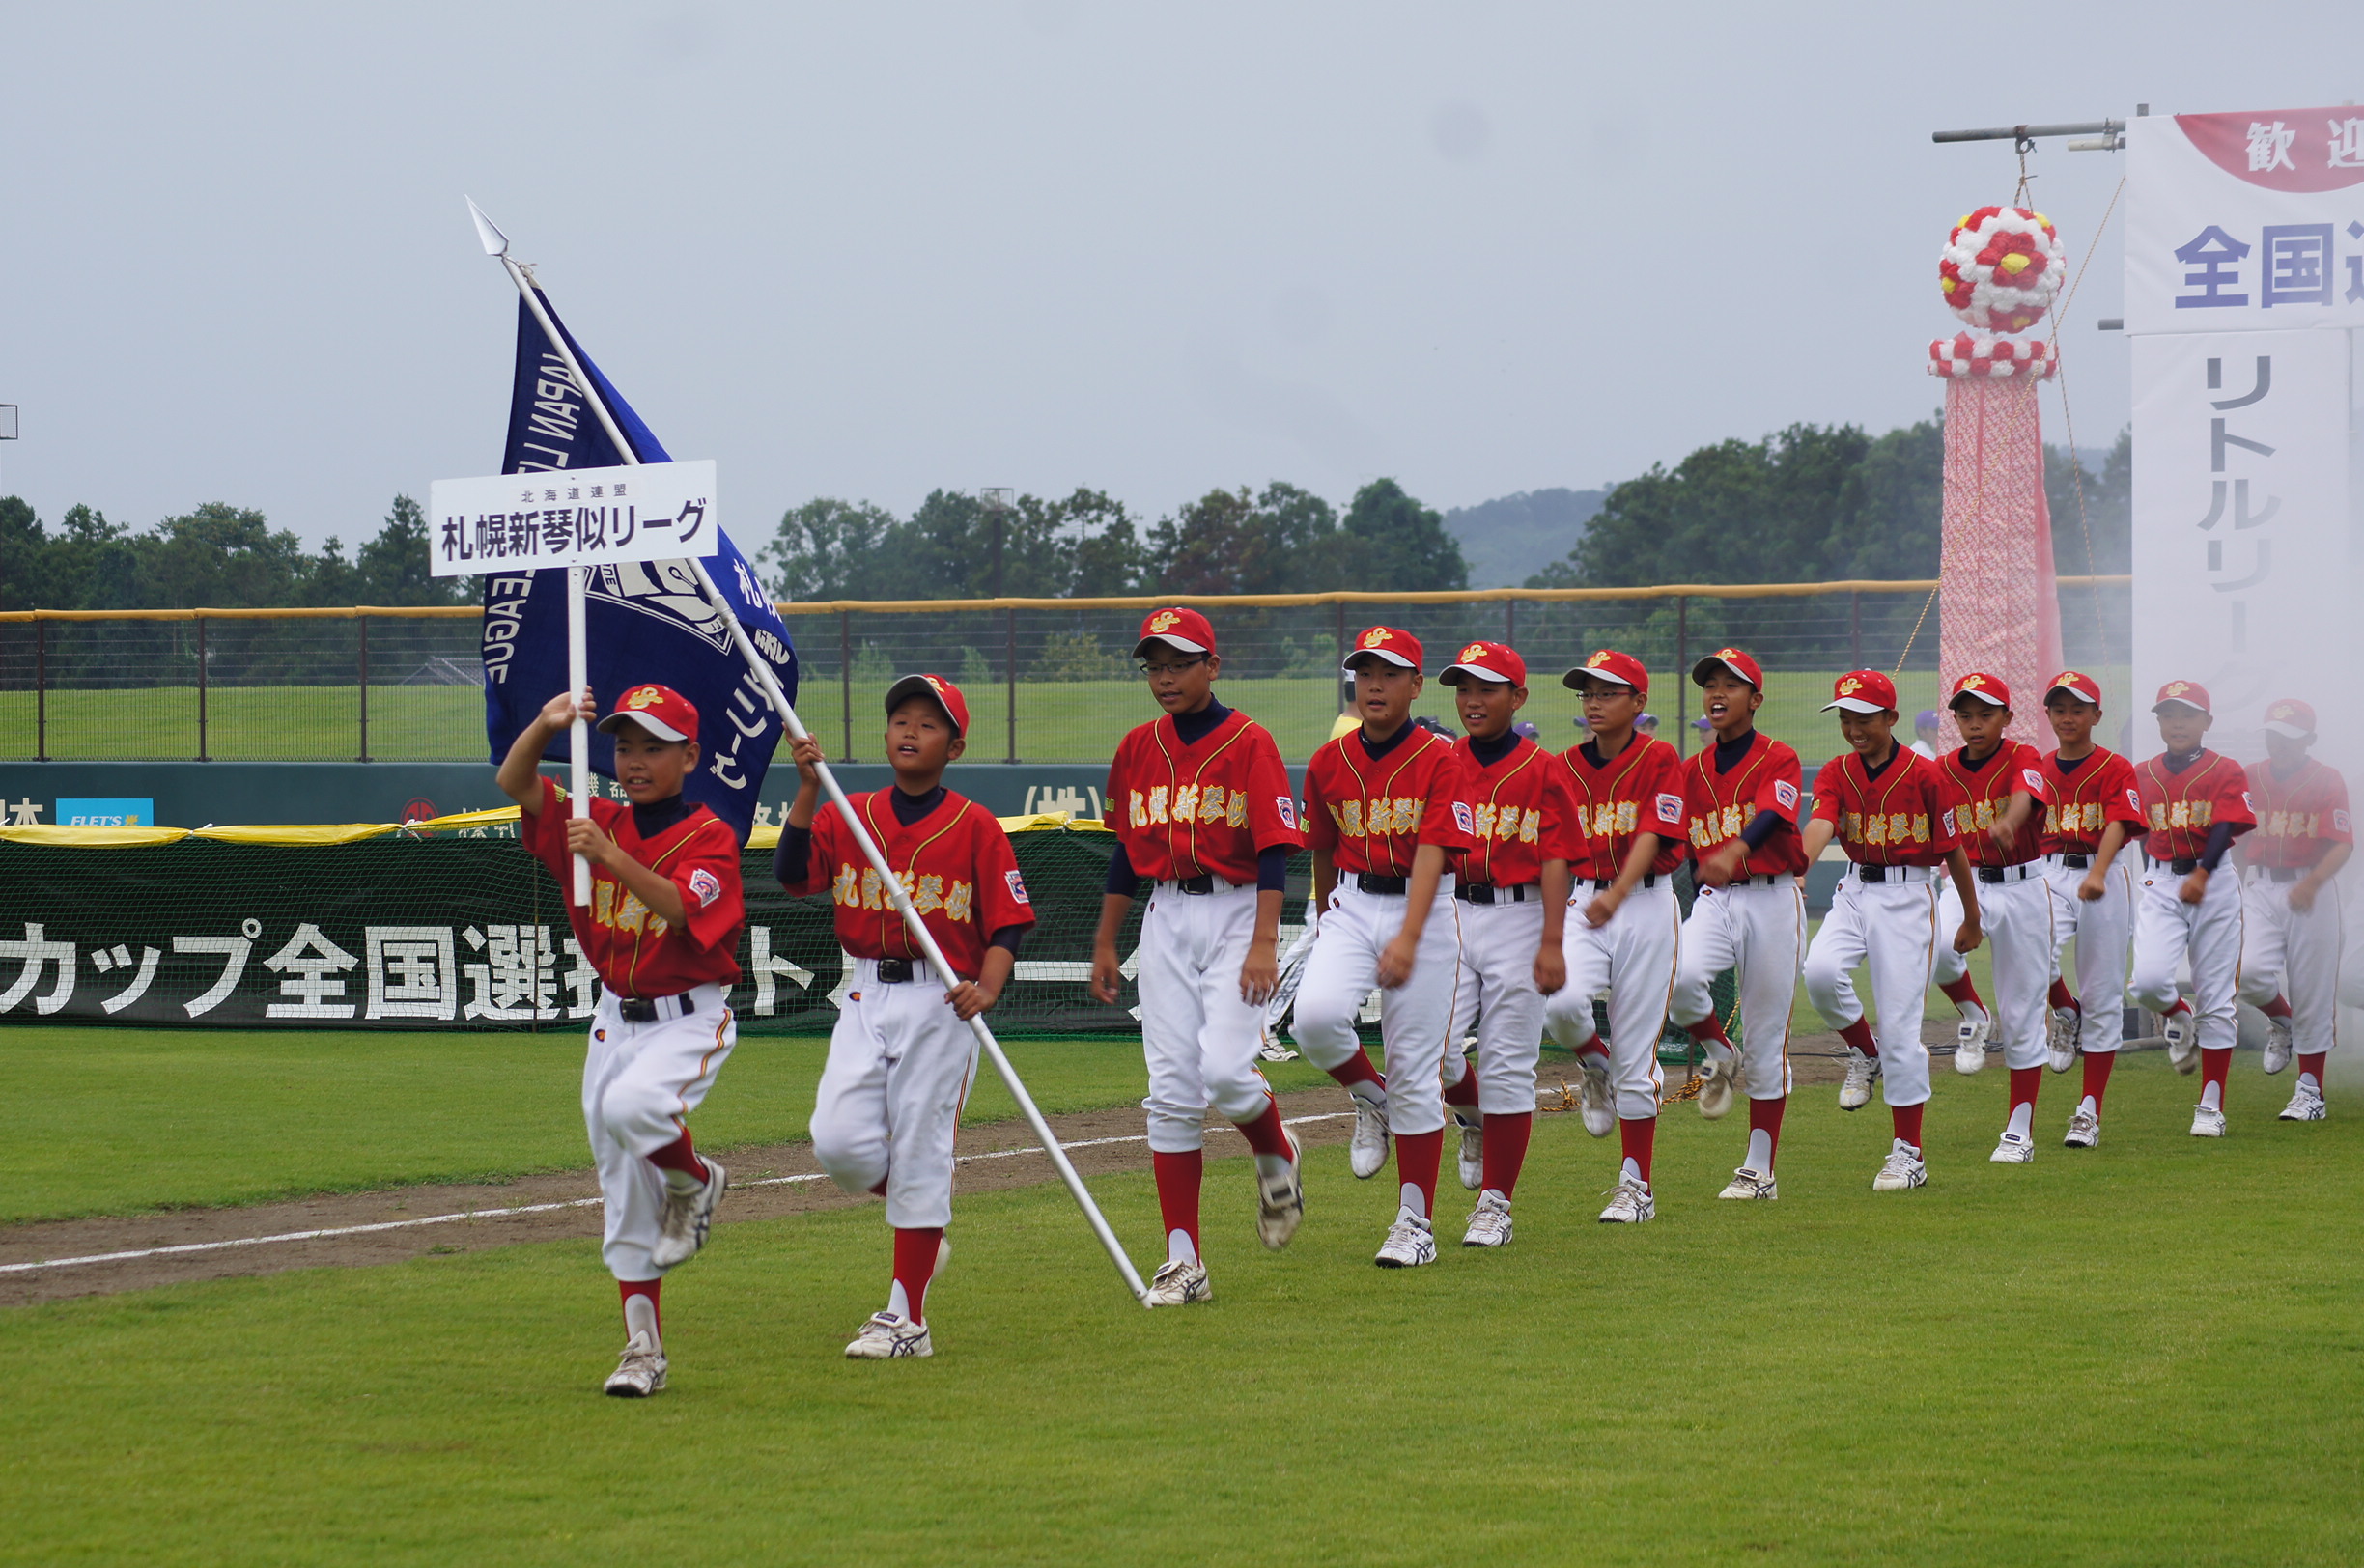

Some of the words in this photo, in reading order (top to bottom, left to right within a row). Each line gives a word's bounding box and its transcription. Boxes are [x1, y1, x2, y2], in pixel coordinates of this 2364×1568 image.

[521, 483, 627, 503] 北海道連盟
[441, 497, 708, 562] 札幌新琴似リーグ
[70, 815, 122, 826] FLET'S
[1129, 783, 1250, 829] 札幌新琴似
